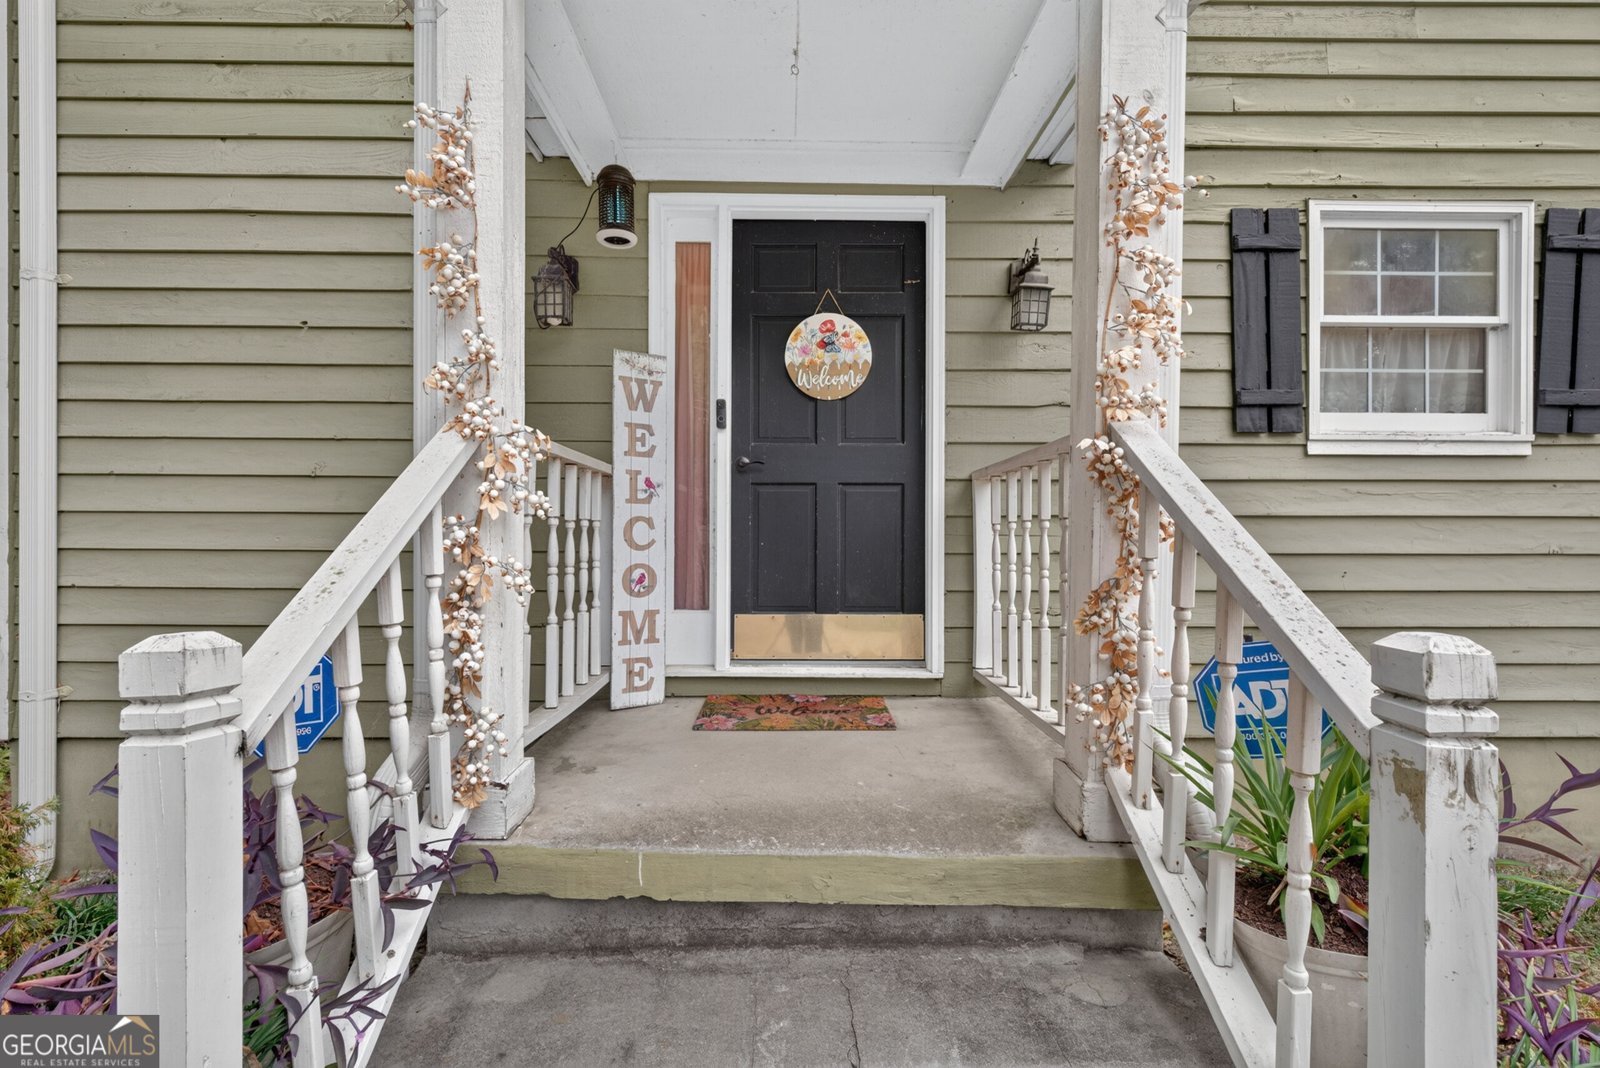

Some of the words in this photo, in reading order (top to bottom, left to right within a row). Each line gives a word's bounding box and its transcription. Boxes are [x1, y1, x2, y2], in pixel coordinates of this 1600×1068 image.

[798, 364, 866, 389] Welcome
[618, 375, 662, 694] WELCOME
[1242, 653, 1269, 664] ured
[1270, 652, 1284, 662] by
